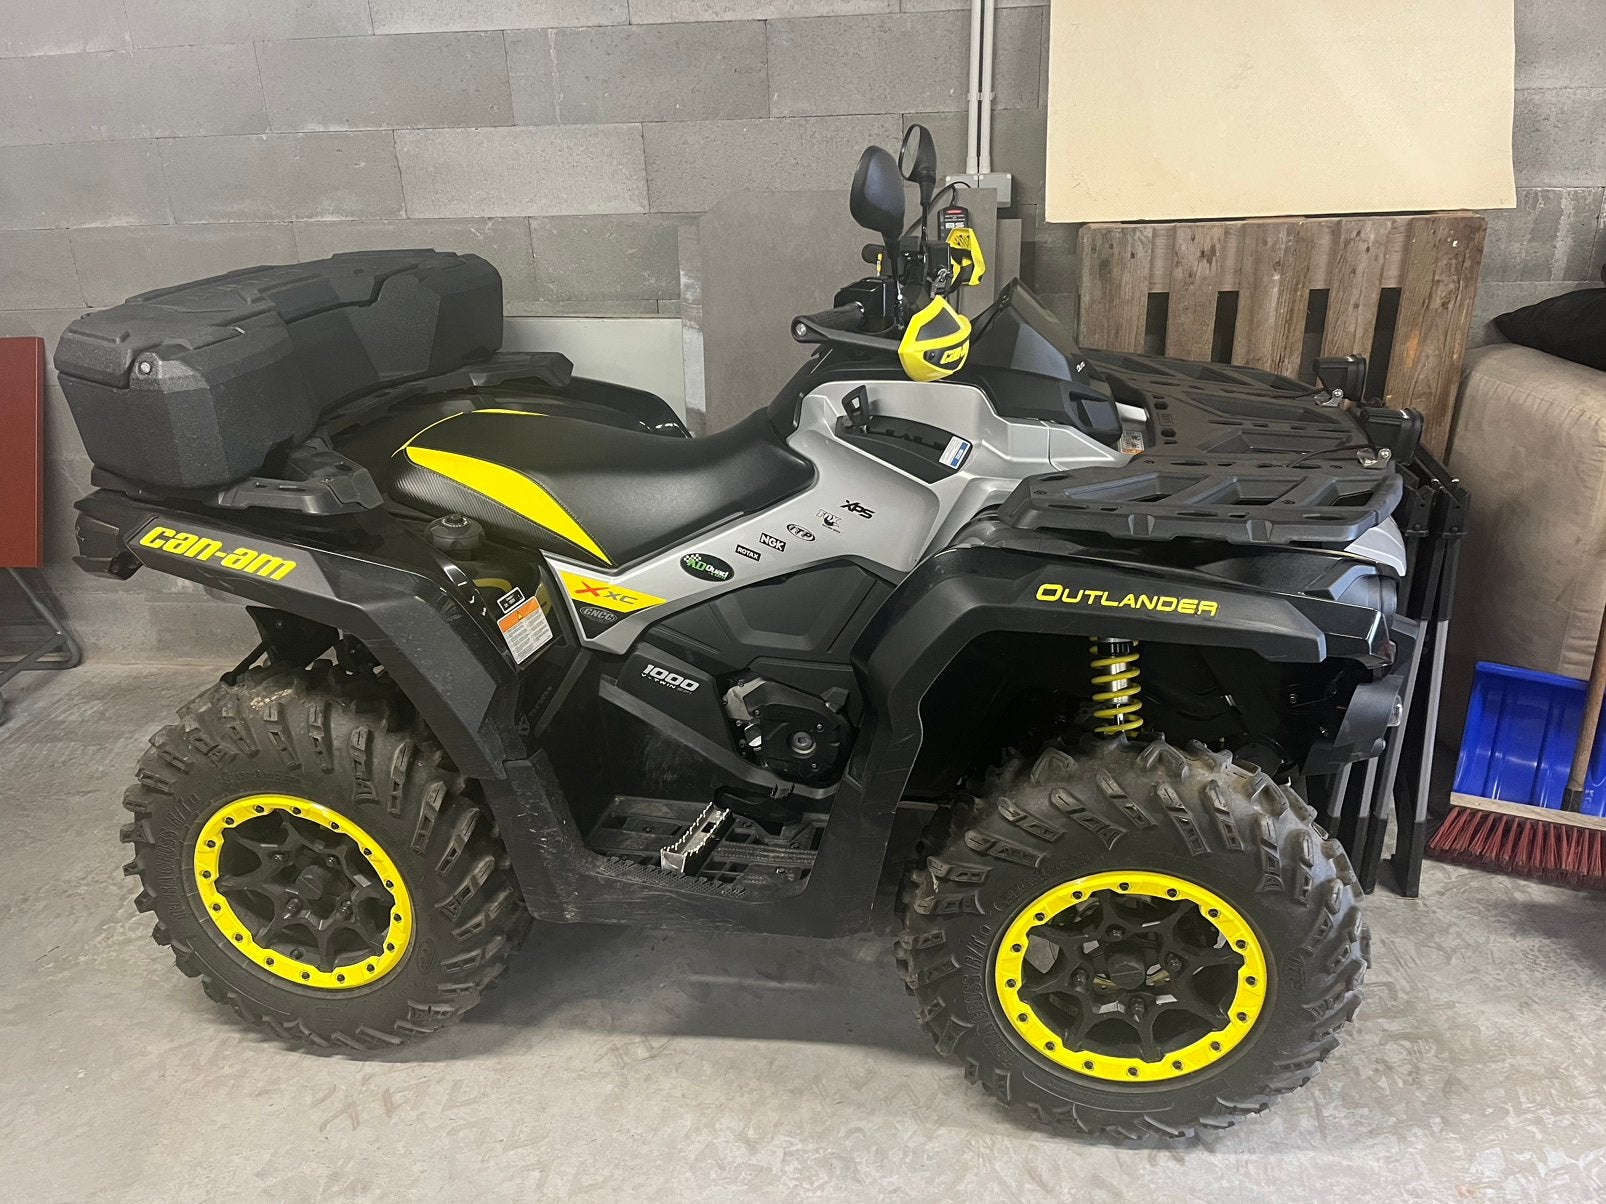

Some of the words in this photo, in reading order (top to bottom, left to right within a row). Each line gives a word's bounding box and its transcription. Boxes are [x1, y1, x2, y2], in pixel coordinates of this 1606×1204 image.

[840, 500, 875, 519] XPS
[788, 526, 813, 539] ITP
[760, 534, 785, 552] NGK
[139, 526, 297, 581] can-am
[737, 547, 759, 560] ROTAX
[583, 608, 615, 621] GNCC
[643, 664, 700, 691] 1000
